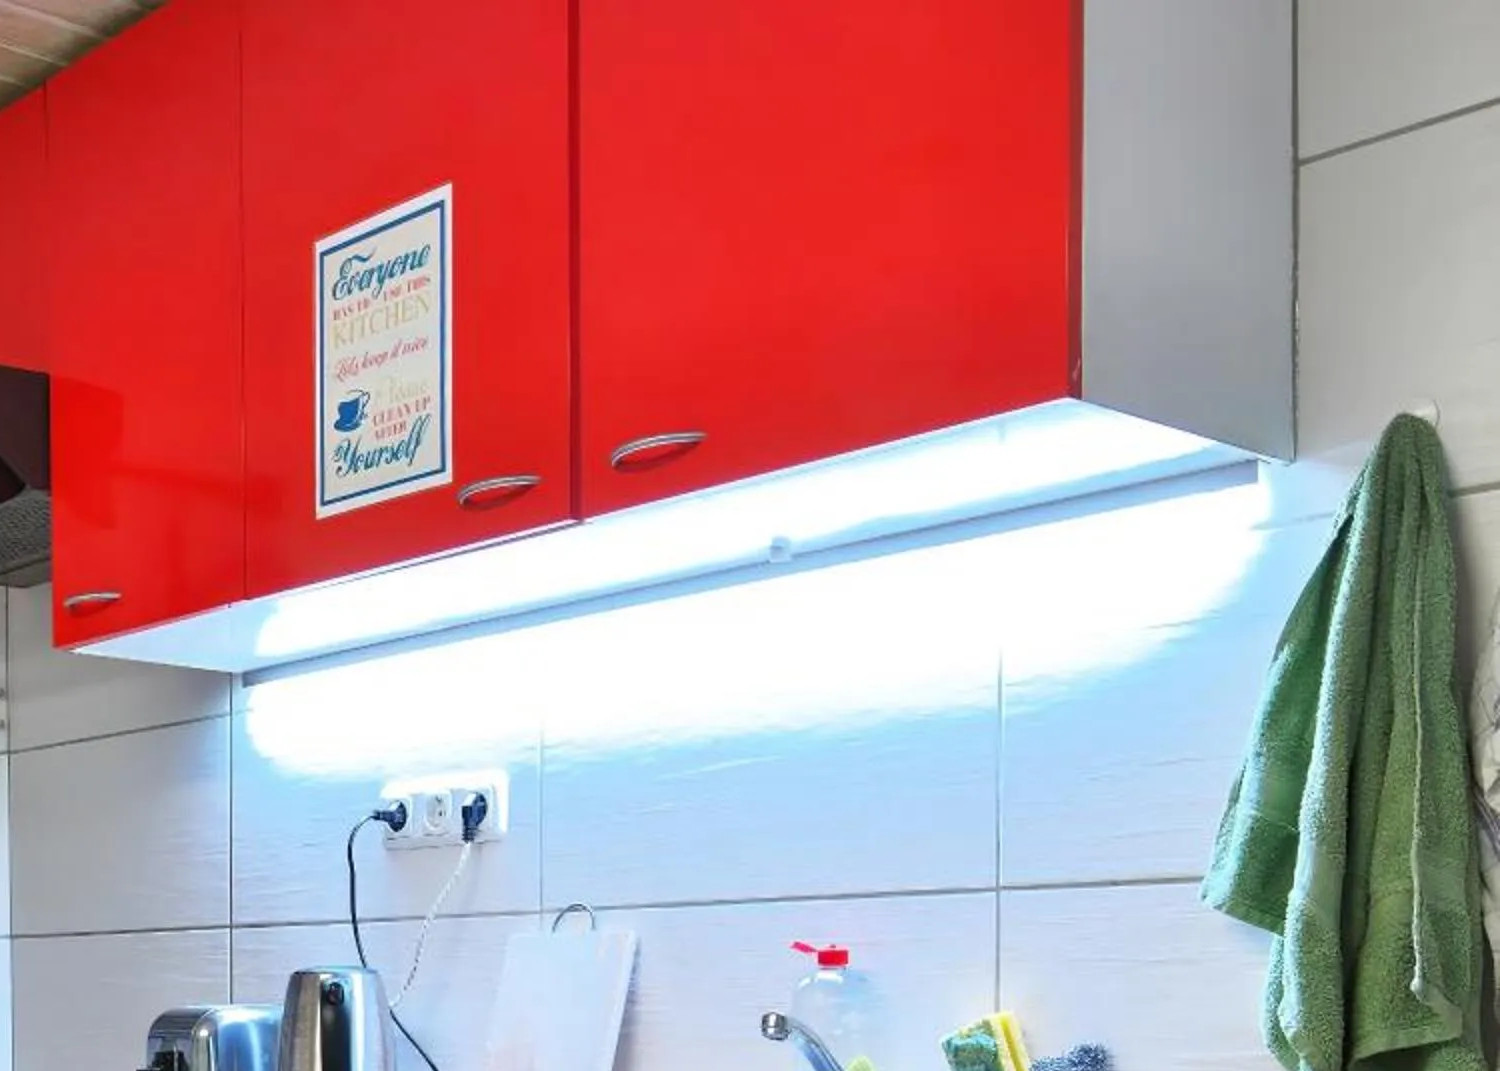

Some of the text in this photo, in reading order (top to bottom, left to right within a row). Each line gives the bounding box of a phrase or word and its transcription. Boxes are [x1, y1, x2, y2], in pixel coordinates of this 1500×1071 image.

[332, 243, 431, 301] Everyone
[333, 294, 430, 349] KITCHEN
[331, 413, 431, 477] Yourself
